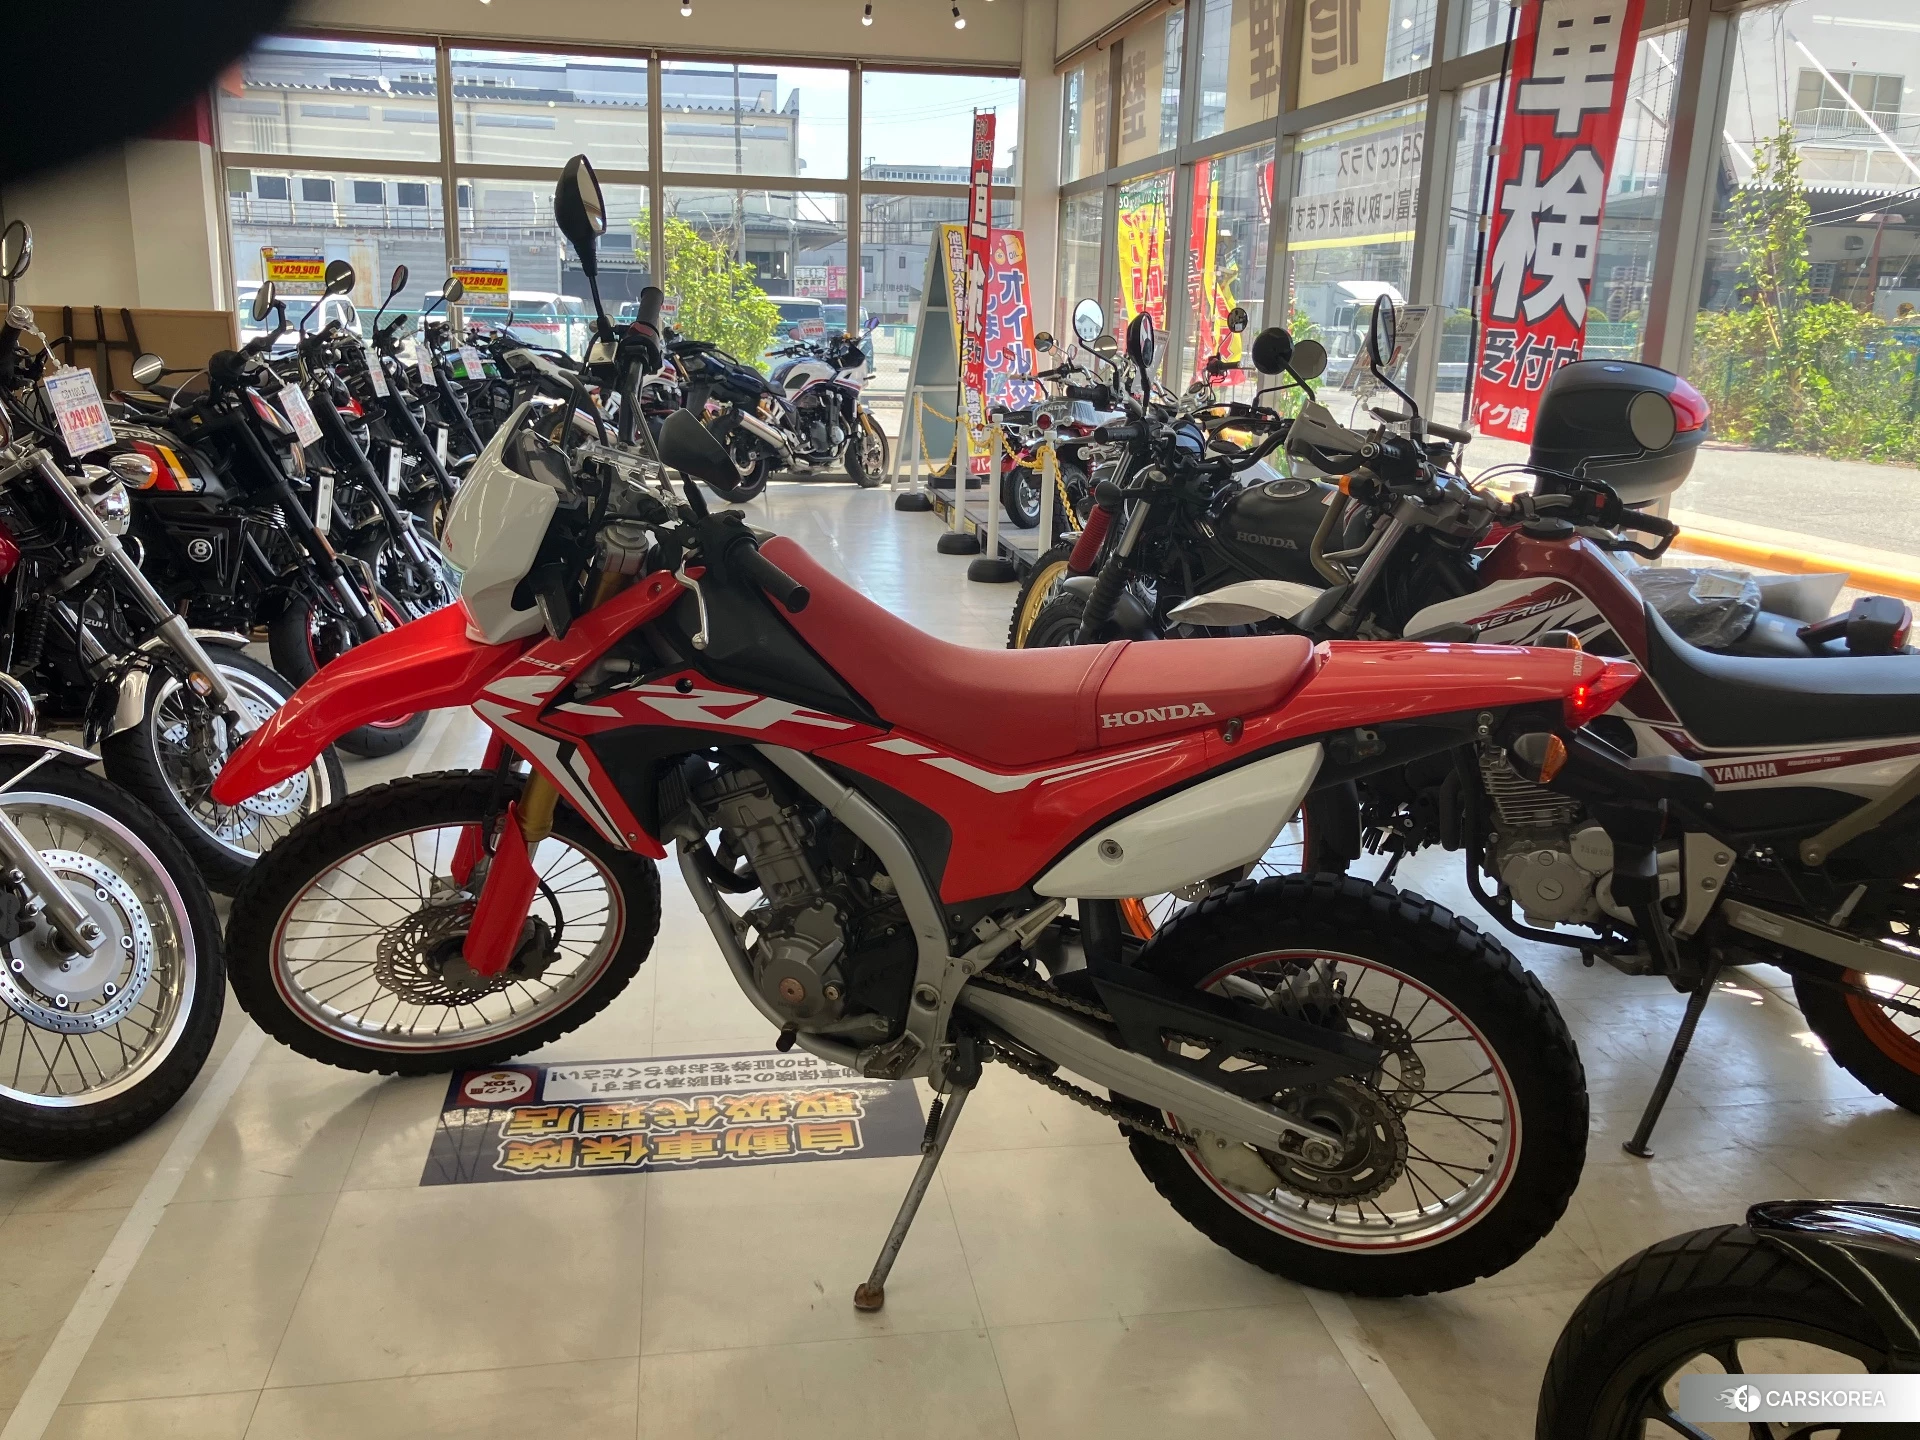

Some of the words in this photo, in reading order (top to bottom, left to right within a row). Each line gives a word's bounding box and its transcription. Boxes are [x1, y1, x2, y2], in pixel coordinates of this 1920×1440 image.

[1236, 531, 1298, 550] HONDA
[1100, 702, 1216, 729] HONDA
[1714, 762, 1778, 782] YAMAHA
[506, 1087, 860, 1137] 取扱代理店
[502, 1119, 856, 1170] 自動車保険
